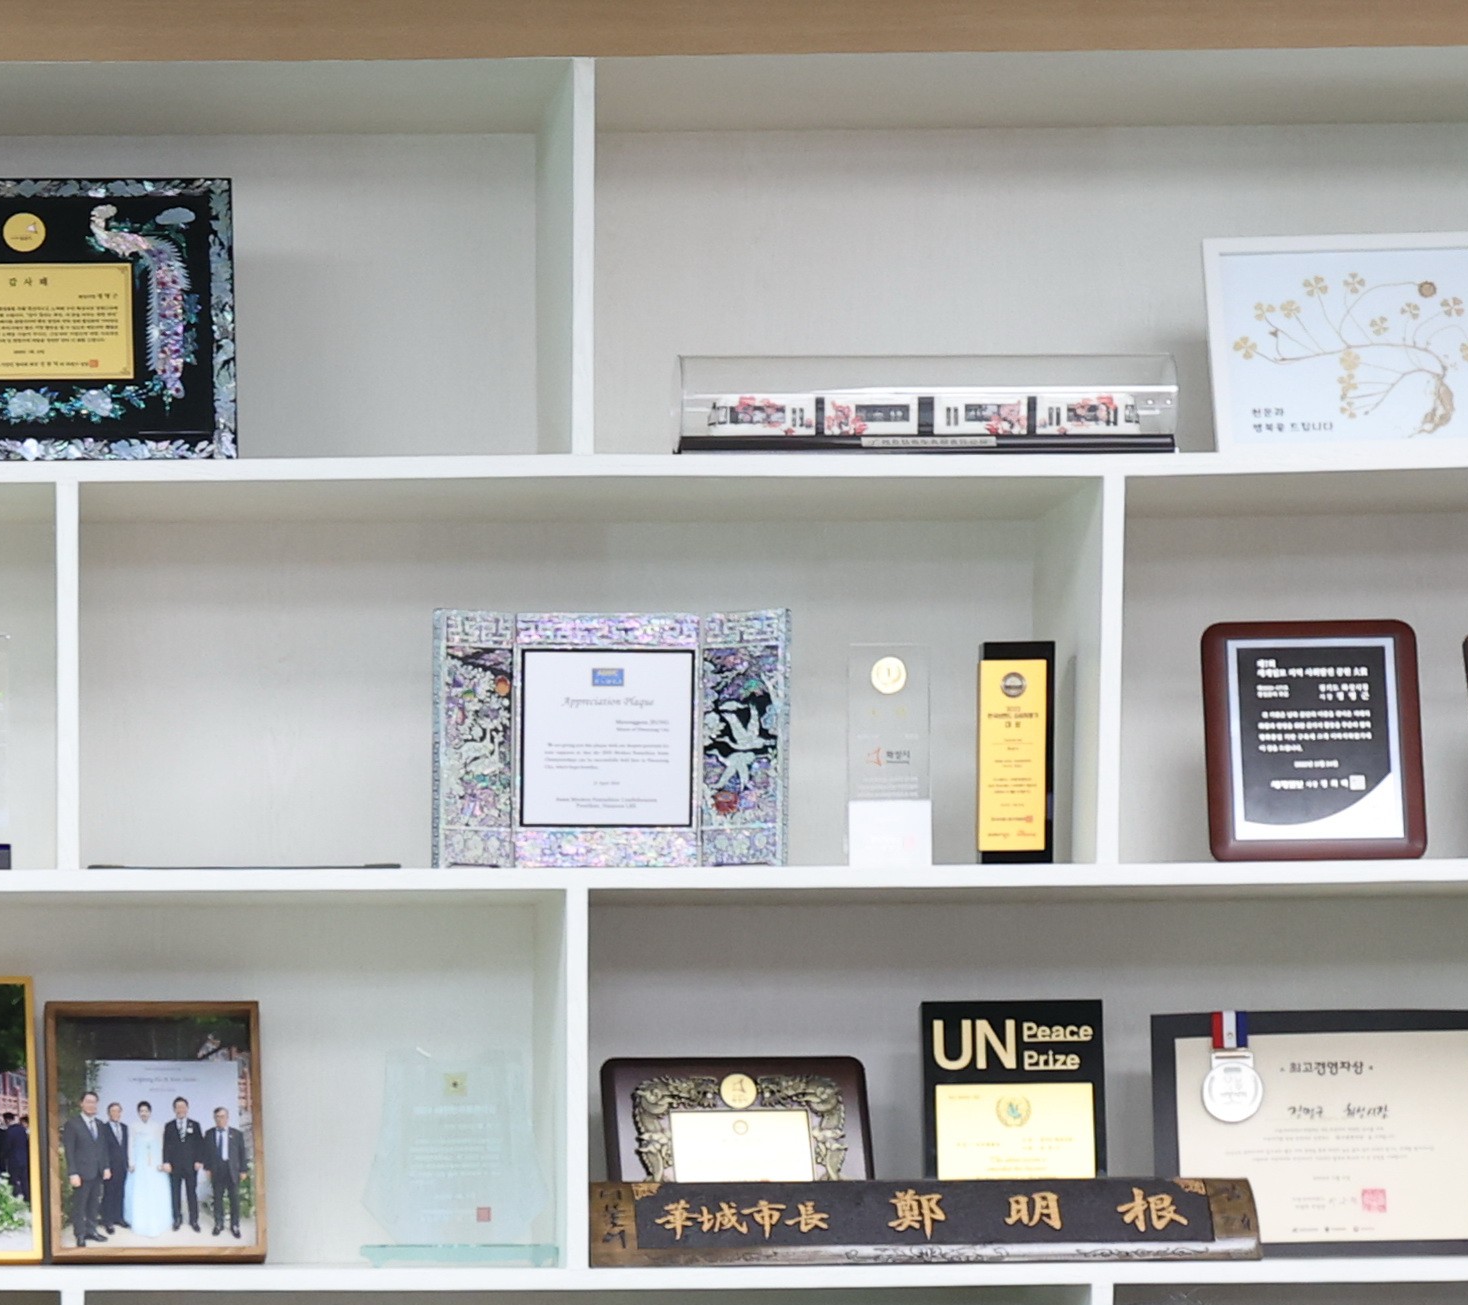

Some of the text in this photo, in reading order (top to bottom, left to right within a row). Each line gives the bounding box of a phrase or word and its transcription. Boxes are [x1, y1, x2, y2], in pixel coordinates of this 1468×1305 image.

[561, 696, 654, 709] Appreciation Plaque
[1022, 1021, 1093, 1042] Peace
[932, 1018, 1017, 1071] UN
[1023, 1050, 1080, 1071] Prize
[655, 1199, 831, 1241] 華城市長
[887, 1189, 948, 1241] 鄭
[1004, 1190, 1062, 1231] 明
[1117, 1187, 1189, 1232] 根
